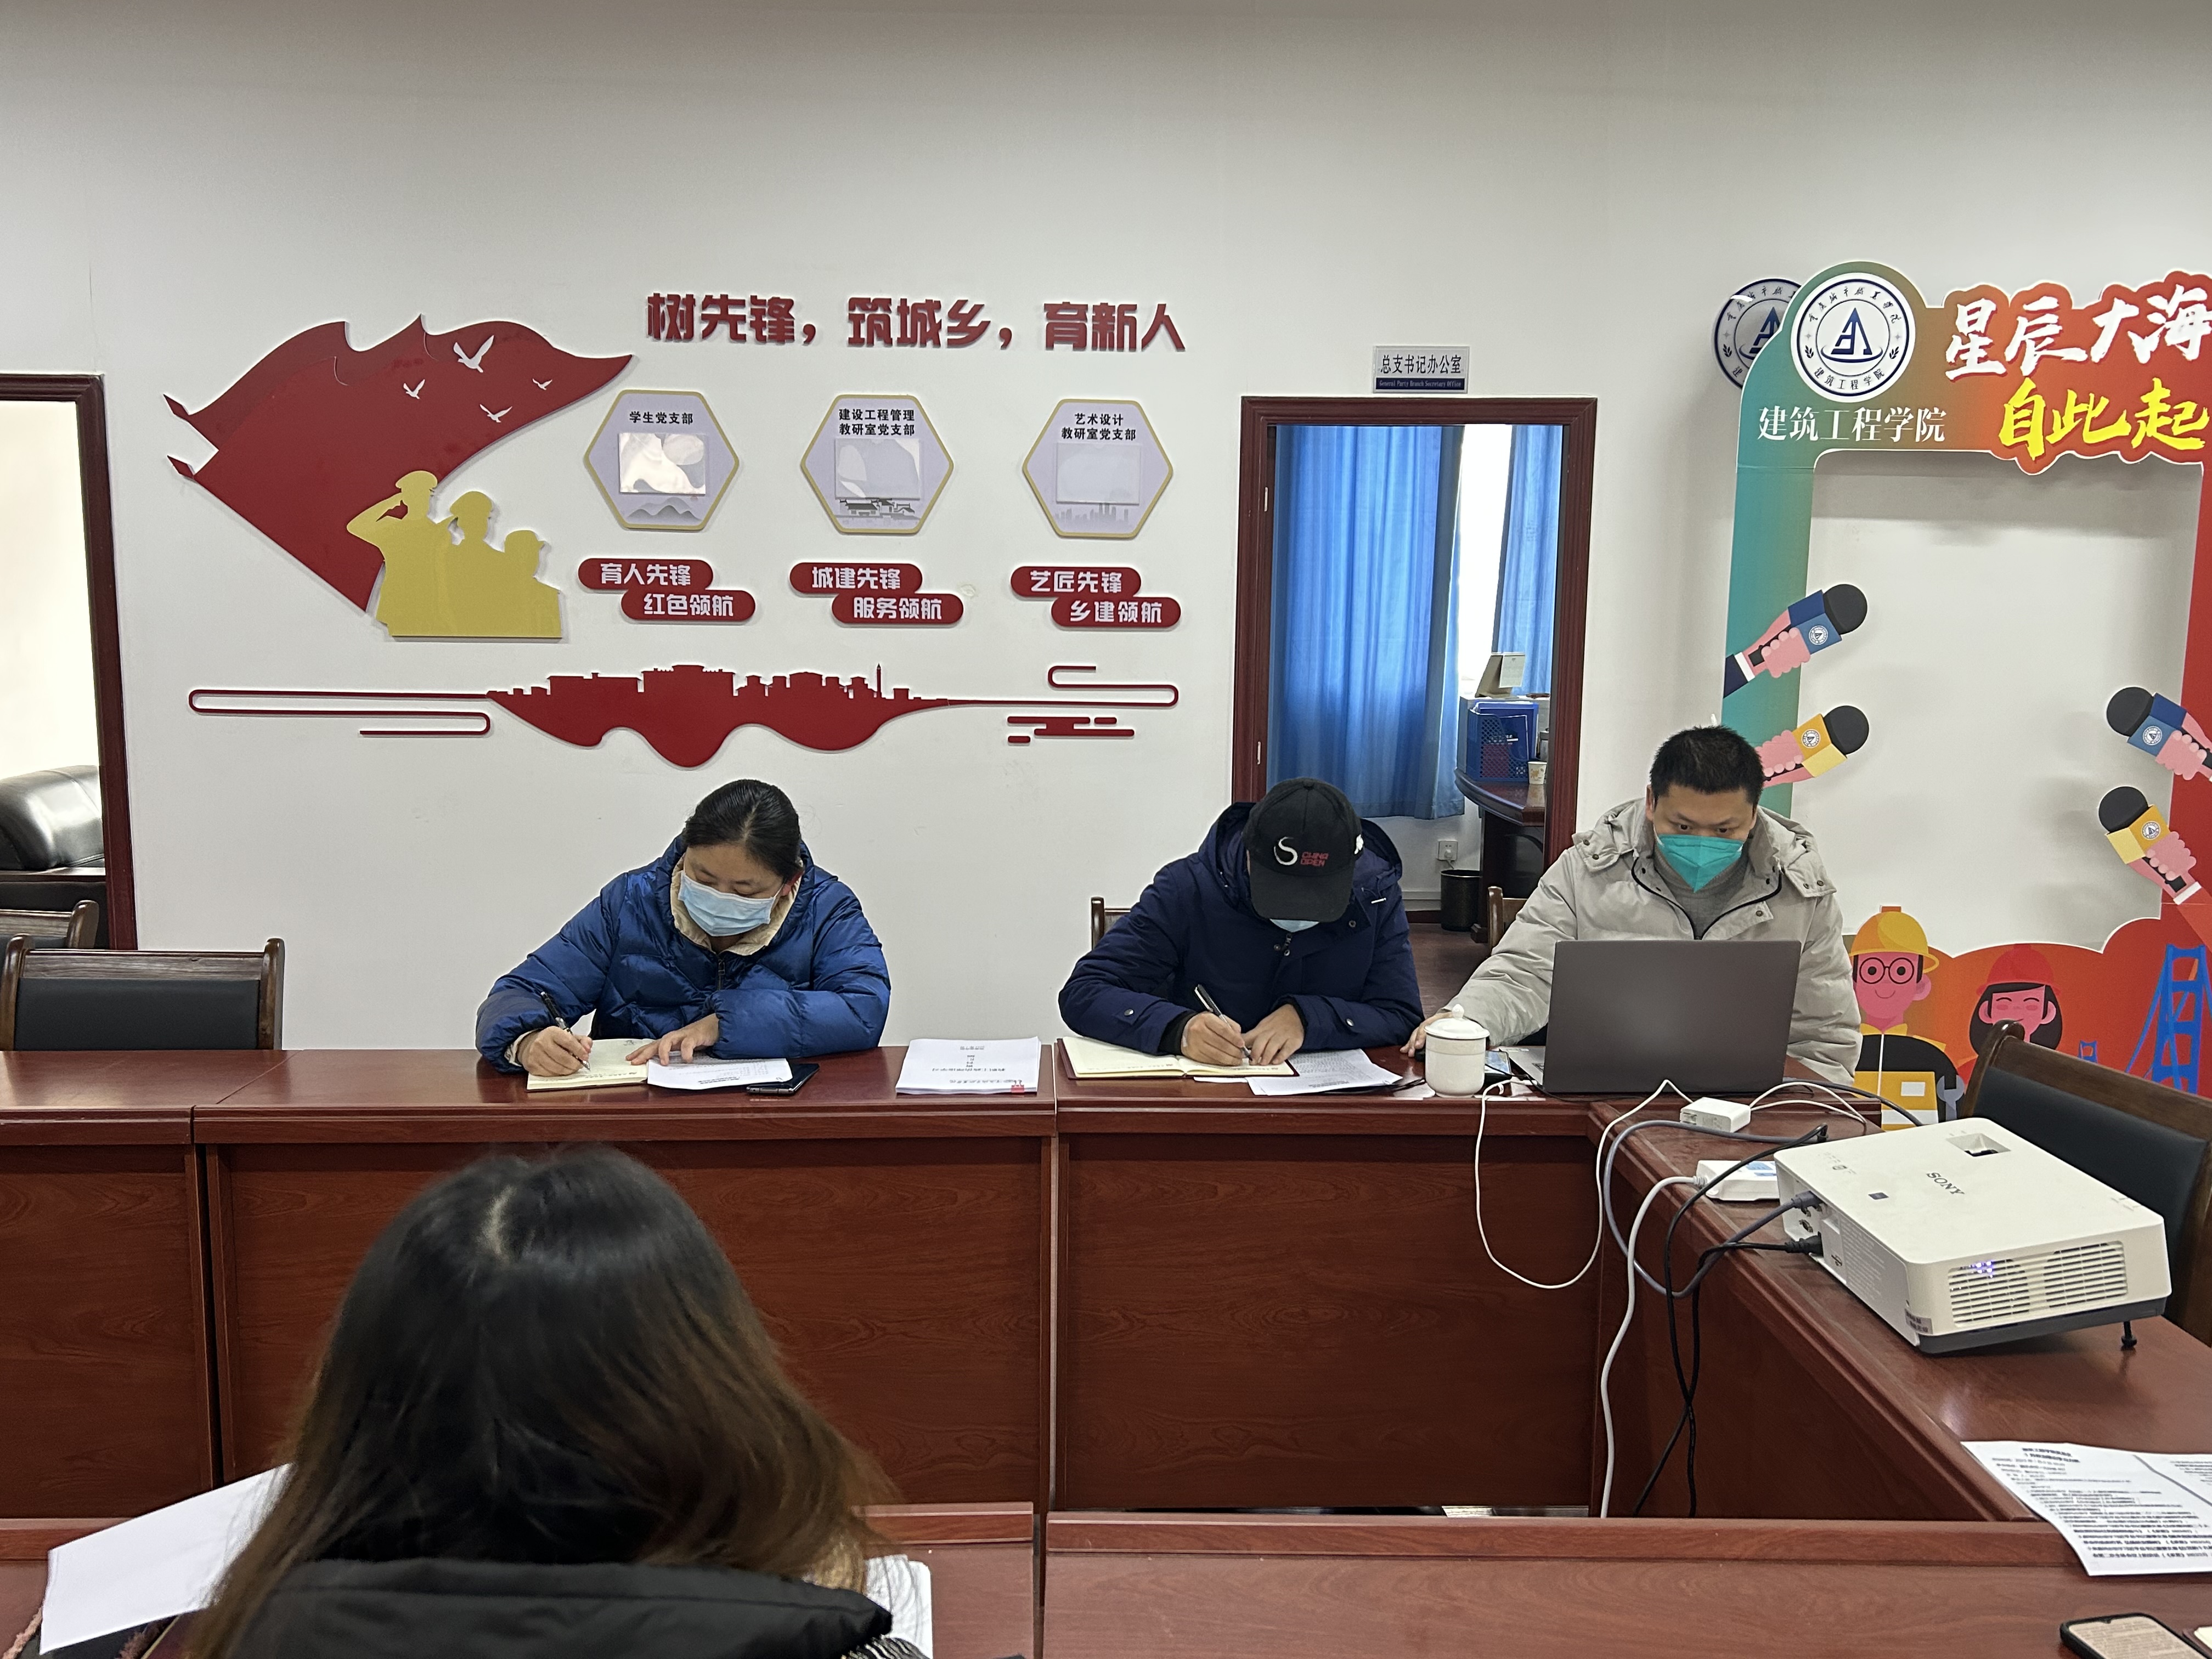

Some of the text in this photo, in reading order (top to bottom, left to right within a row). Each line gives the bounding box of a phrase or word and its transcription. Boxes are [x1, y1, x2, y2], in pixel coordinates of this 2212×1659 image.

[1945, 284, 2212, 381] 星辰大海
[1380, 354, 1462, 374] 总支书记办公室
[1397, 380, 1408, 388] Party
[1814, 366, 1885, 390] 建筑工程学院
[629, 410, 694, 426] 学生党支部
[838, 408, 915, 422] 建设工程管理
[1074, 413, 1124, 427] 艺术设计
[1758, 406, 1946, 442] 建筑工程学院
[2000, 377, 2210, 460] 自此起
[838, 422, 915, 437] 教研室党支部
[1061, 427, 1136, 442] 教研室党支部
[600, 563, 691, 586] 育人先锋
[811, 567, 900, 590] 城建先锋
[1030, 570, 1122, 593] 艺匠先锋
[644, 594, 733, 617] 红色领航
[854, 597, 942, 620] 服务领航
[1070, 601, 1162, 623] 乡建领航
[1926, 1172, 1965, 1196] SONY
